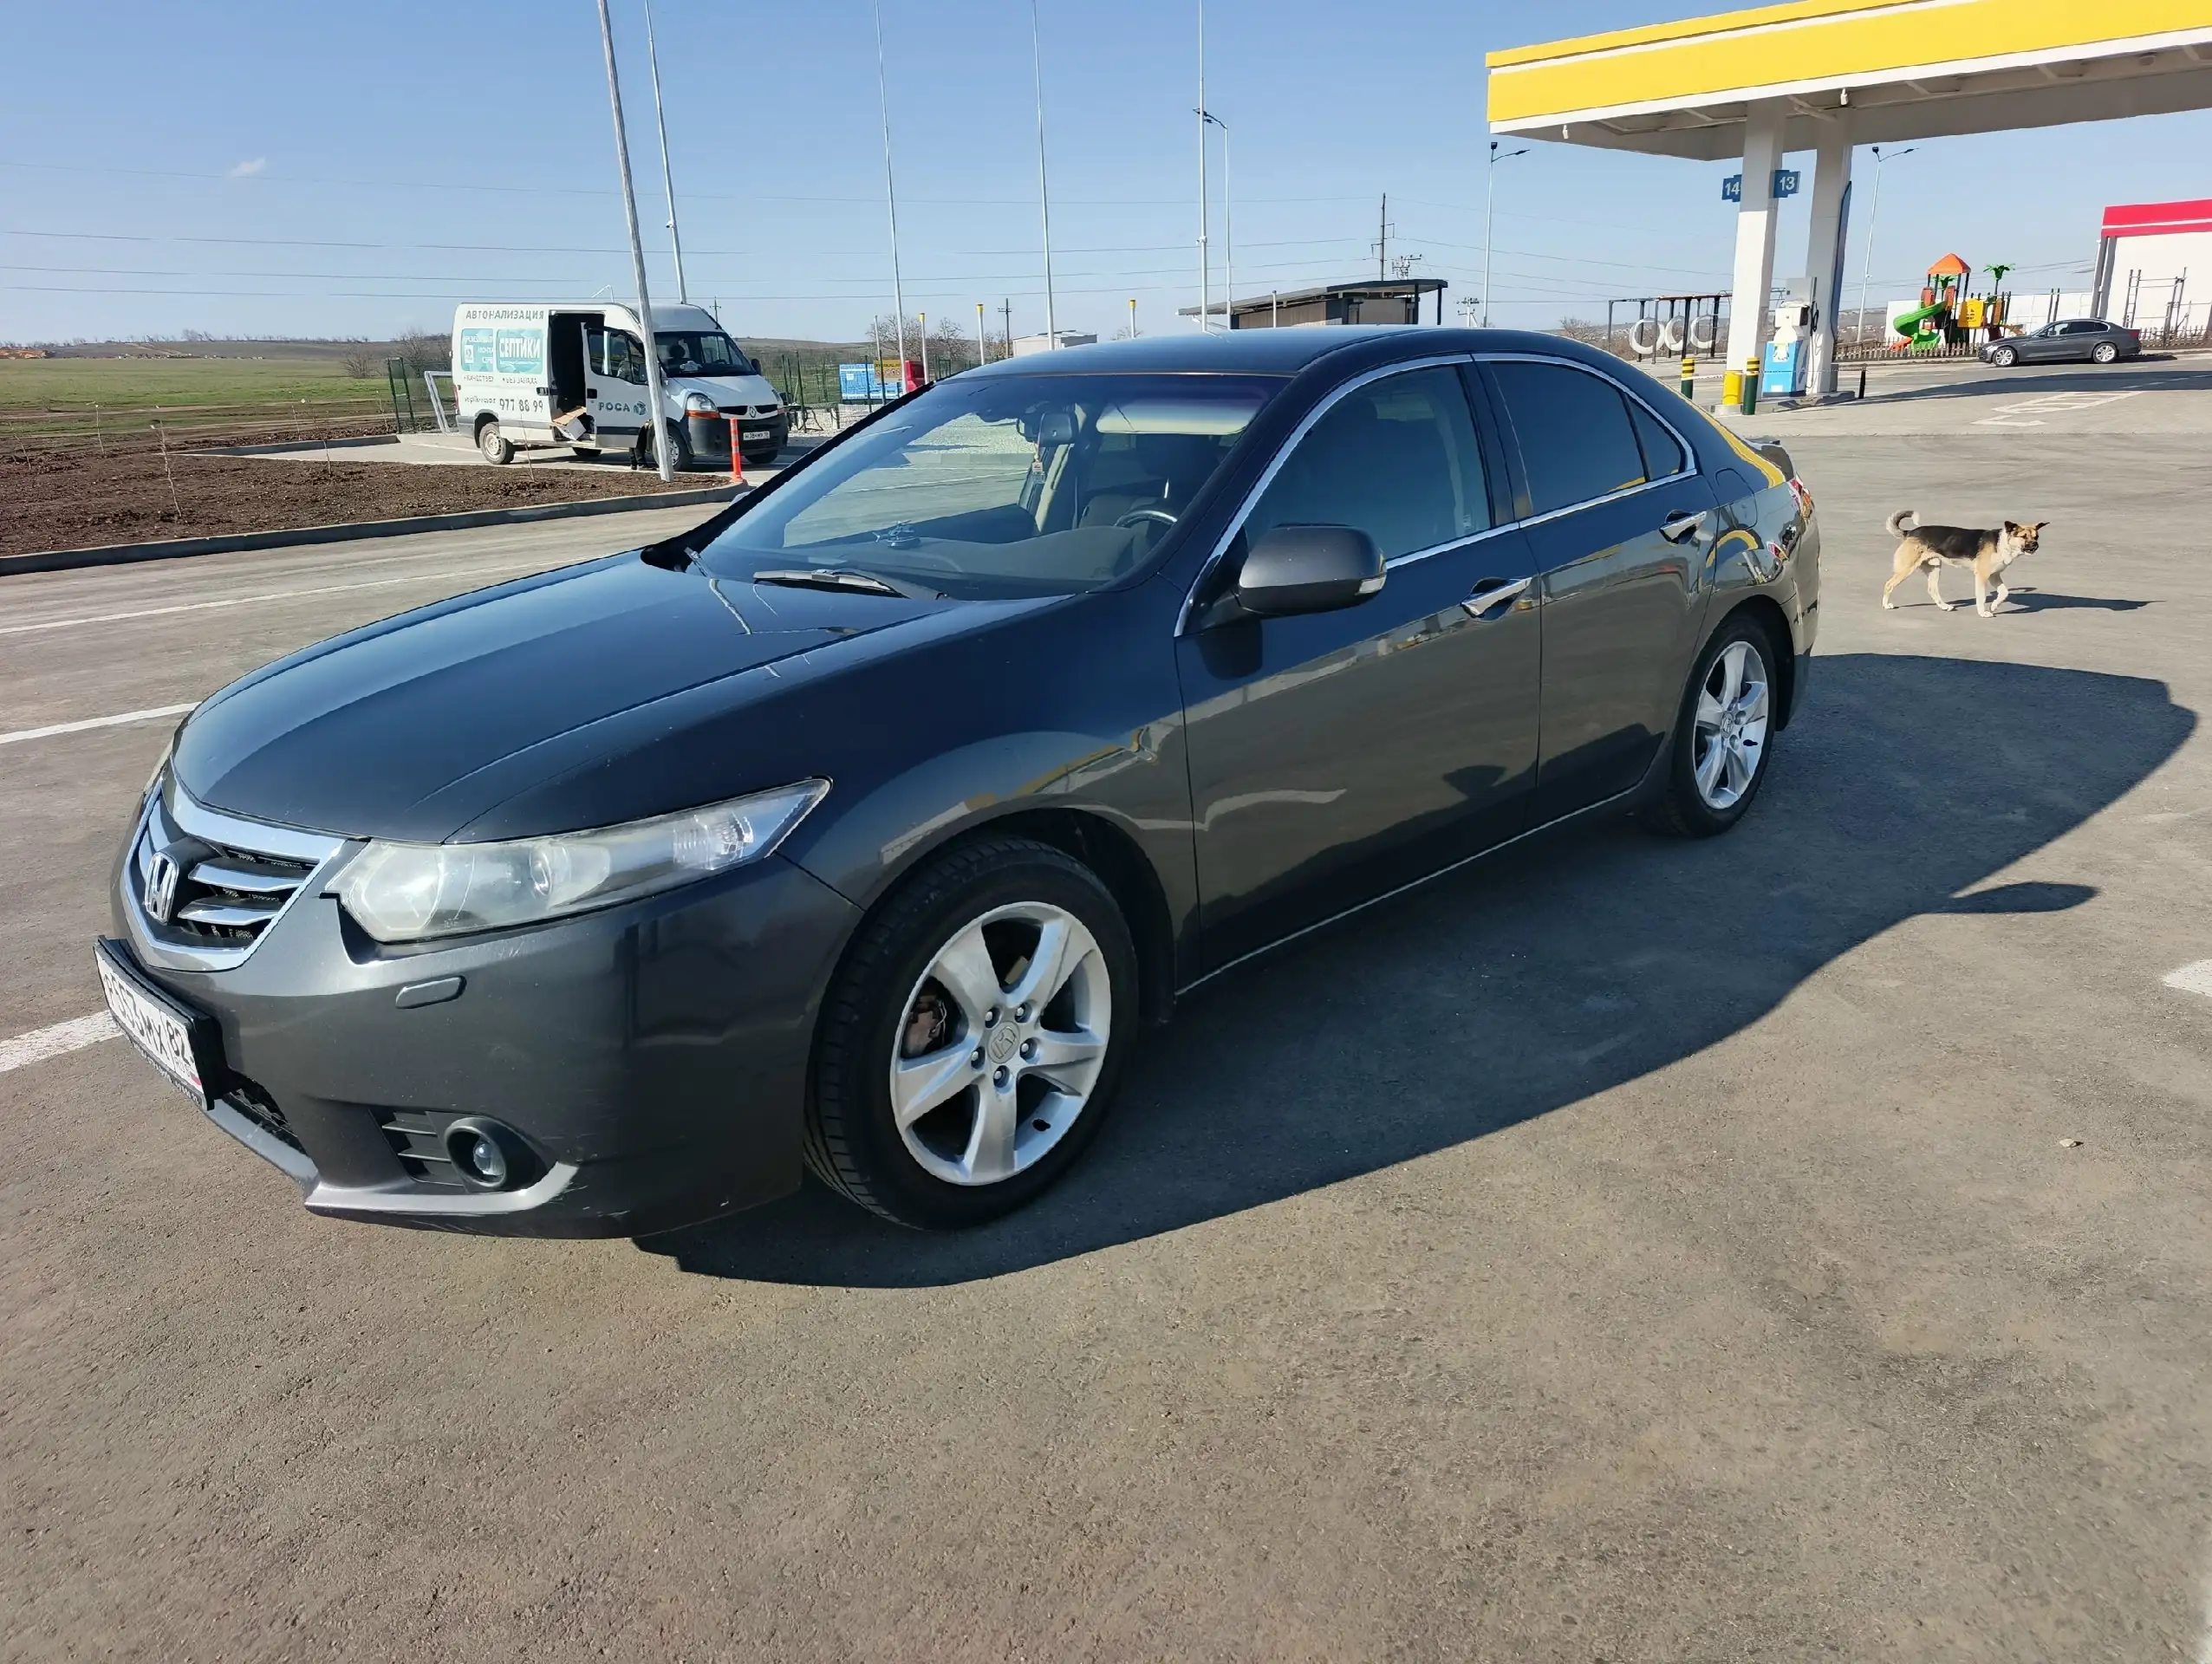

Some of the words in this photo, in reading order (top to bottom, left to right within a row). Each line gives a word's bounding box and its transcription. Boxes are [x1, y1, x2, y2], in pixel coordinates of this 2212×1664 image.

[1725, 181, 1740, 196] 14
[1779, 176, 1795, 192] 13
[499, 337, 541, 358] СЕПТИКИ
[499, 398, 515, 411] 977
[519, 399, 530, 412] 88
[533, 400, 543, 413] 99
[599, 401, 630, 412] РОСА
[166, 1019, 191, 1067] 82
